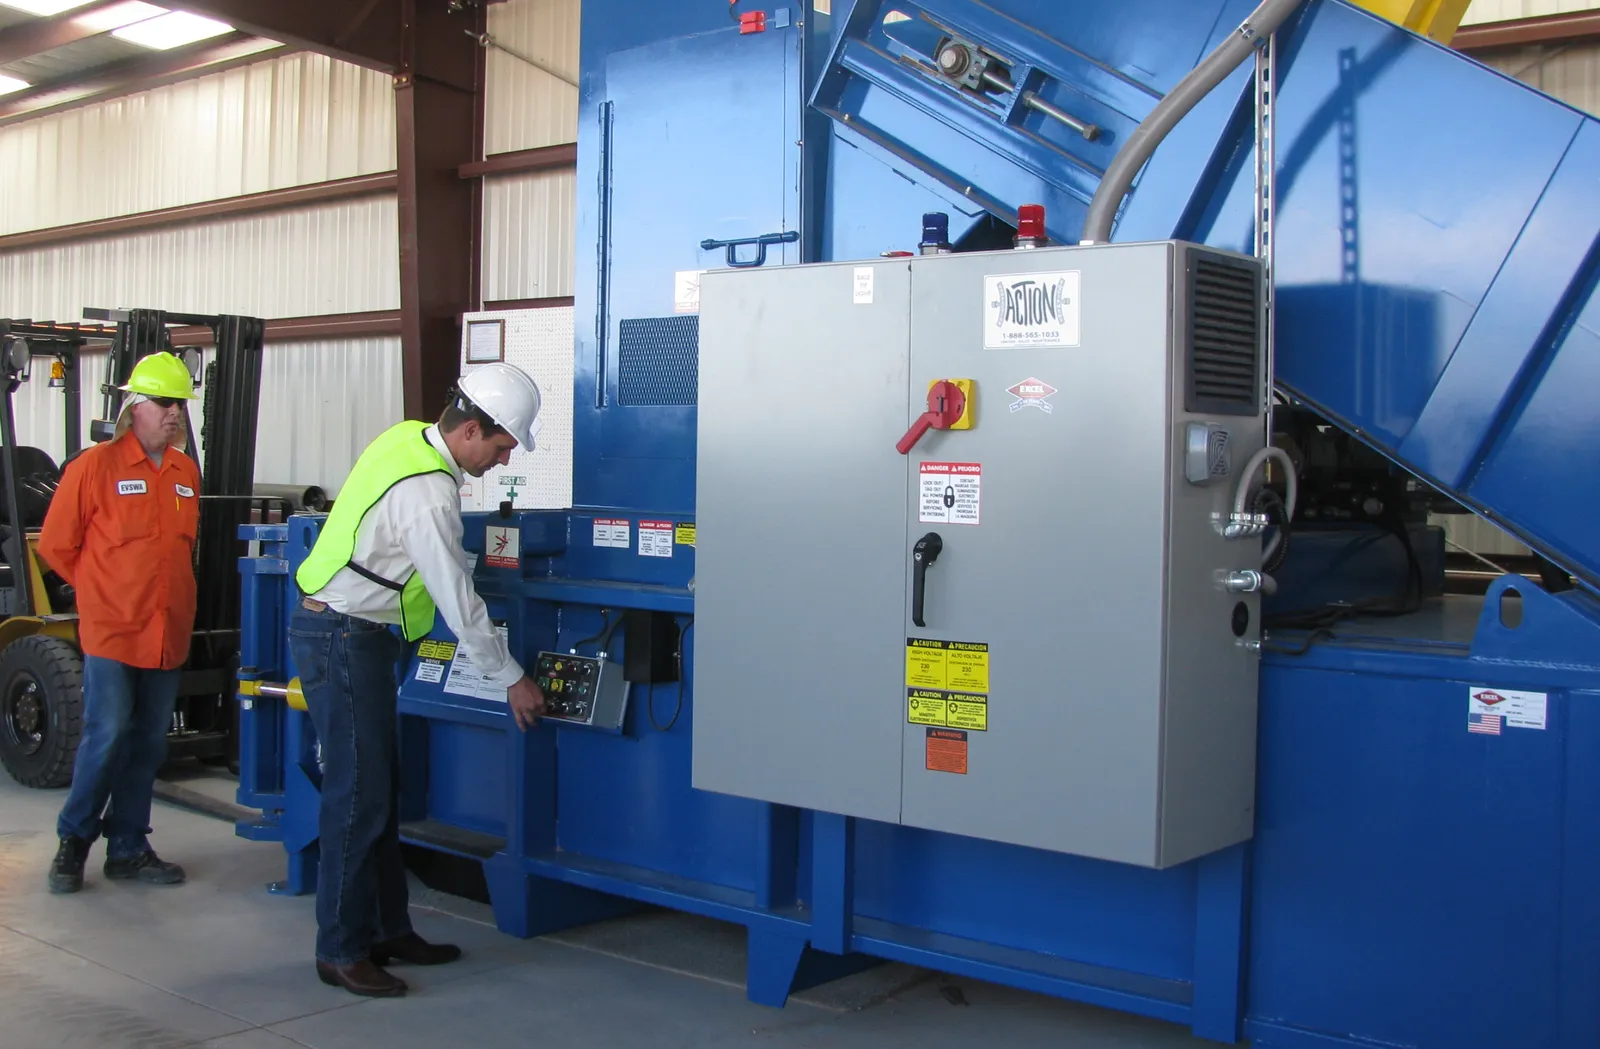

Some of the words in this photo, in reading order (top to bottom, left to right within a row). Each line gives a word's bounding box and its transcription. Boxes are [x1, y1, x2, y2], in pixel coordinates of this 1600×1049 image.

[1005, 280, 1056, 327] ACTION
[1002, 331, 1059, 340] 1-888-565-1033
[1020, 385, 1044, 393] EXCEL
[499, 476, 515, 485] FIRST
[516, 477, 527, 485] AID
[121, 484, 144, 492] EVSWA
[919, 640, 942, 648] CAUTION
[954, 643, 987, 651] PRECAUCION
[919, 691, 942, 699] CAUTION
[954, 694, 986, 702] PRECAUCION
